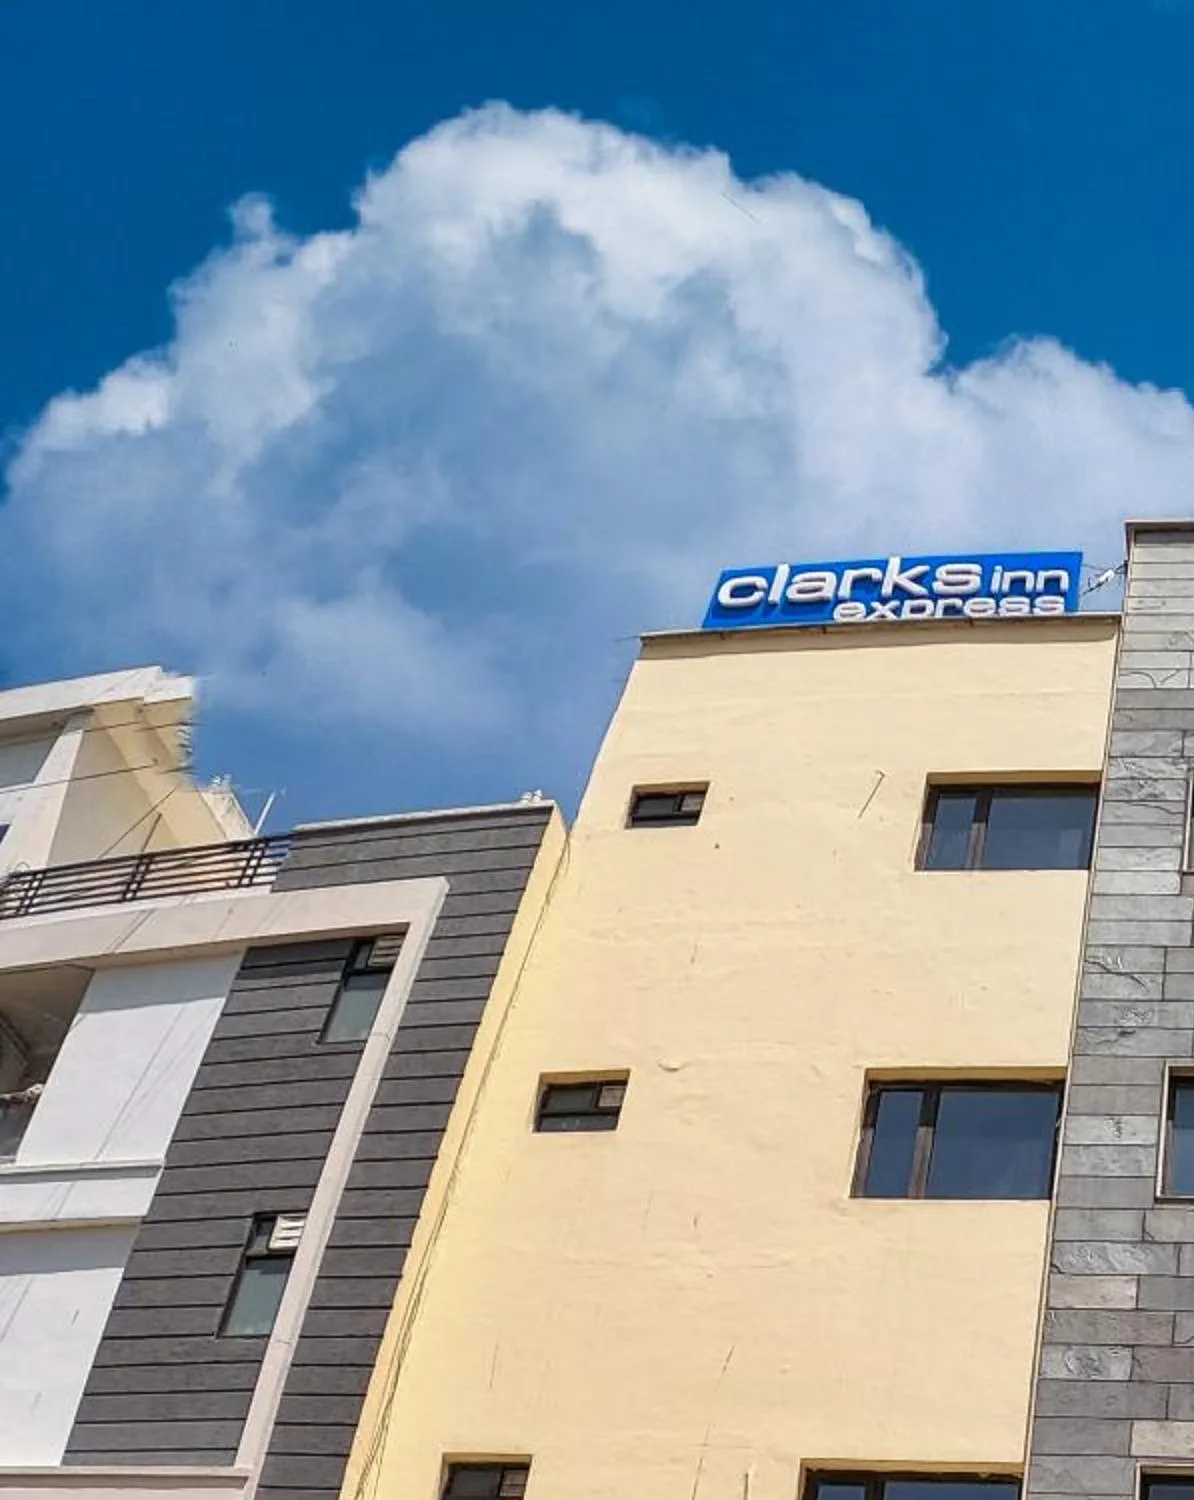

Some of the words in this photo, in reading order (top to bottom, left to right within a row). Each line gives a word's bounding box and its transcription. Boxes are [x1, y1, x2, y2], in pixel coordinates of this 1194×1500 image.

[717, 555, 982, 609] clarks
[989, 564, 1070, 594] inn
[833, 595, 1065, 623] express
